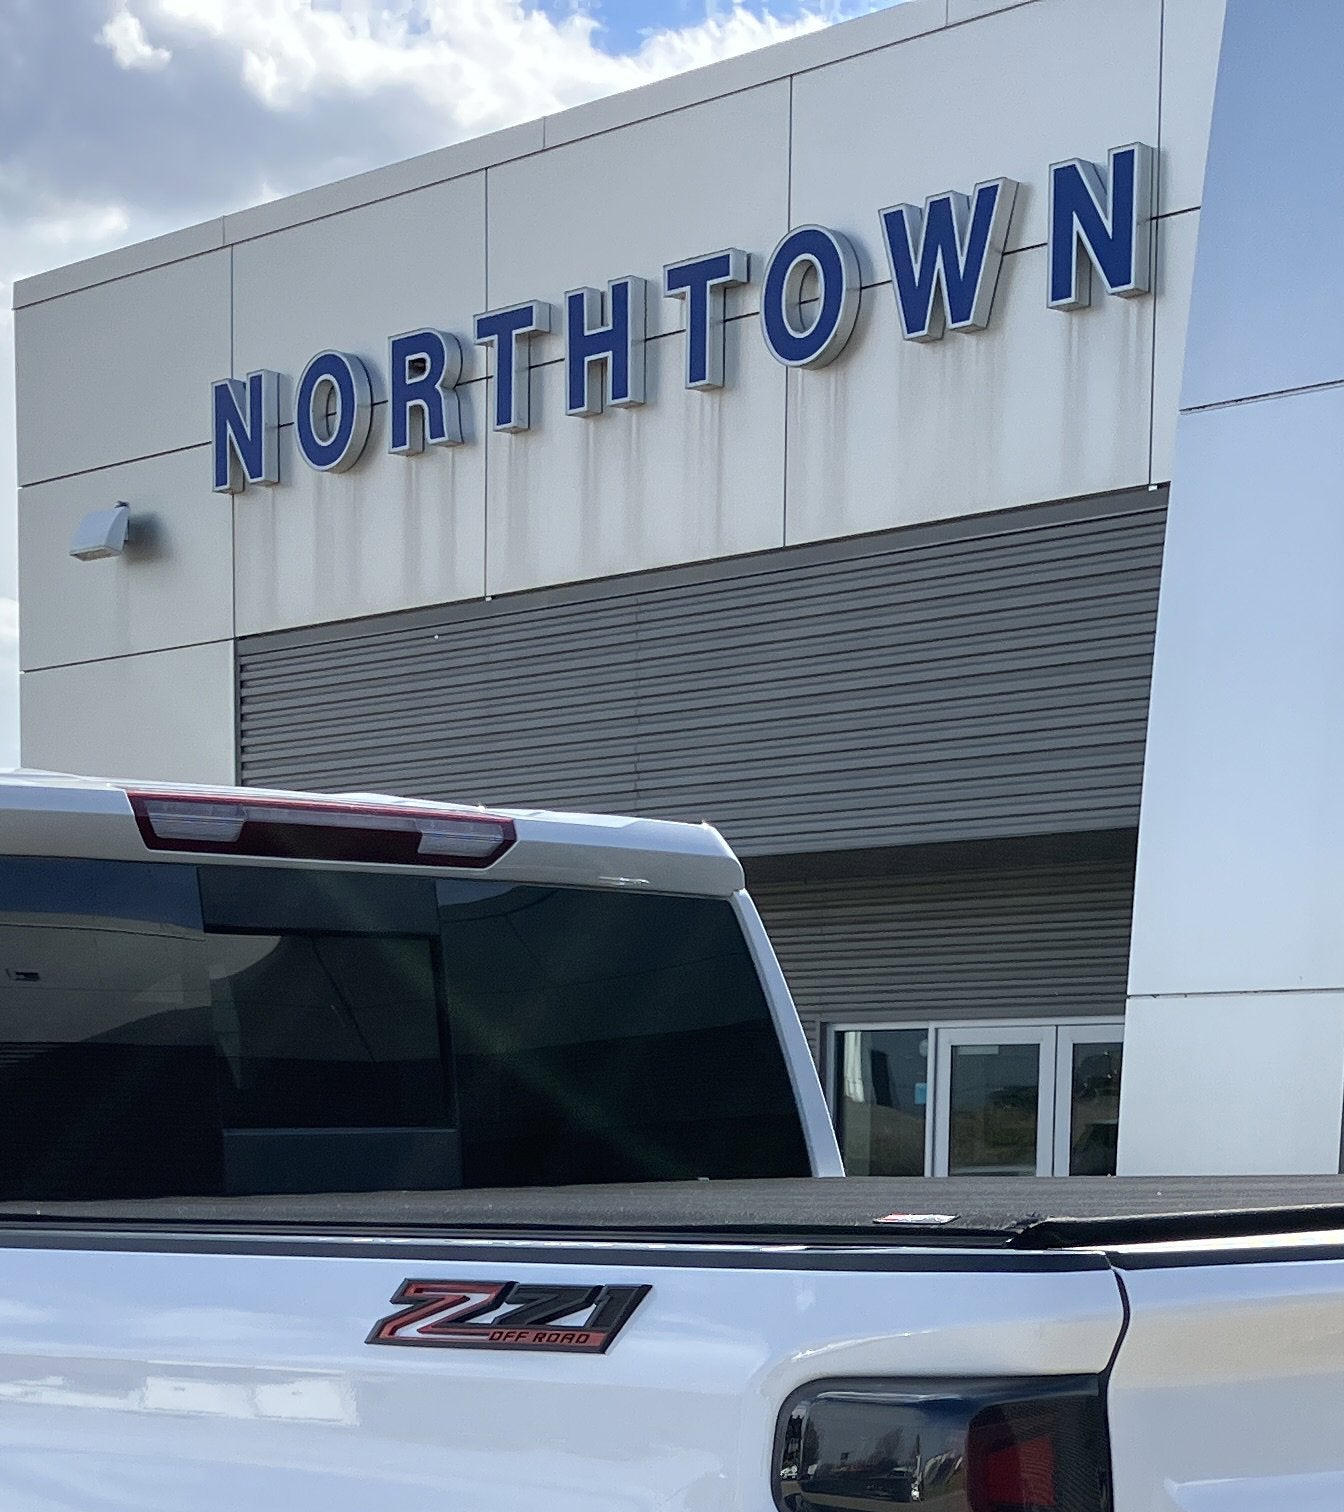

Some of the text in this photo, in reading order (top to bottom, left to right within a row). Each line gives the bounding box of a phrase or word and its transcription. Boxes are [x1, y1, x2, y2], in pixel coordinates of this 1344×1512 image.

[210, 141, 1155, 494] NORTHTOWN
[488, 1329, 591, 1344] OFF ROAD
